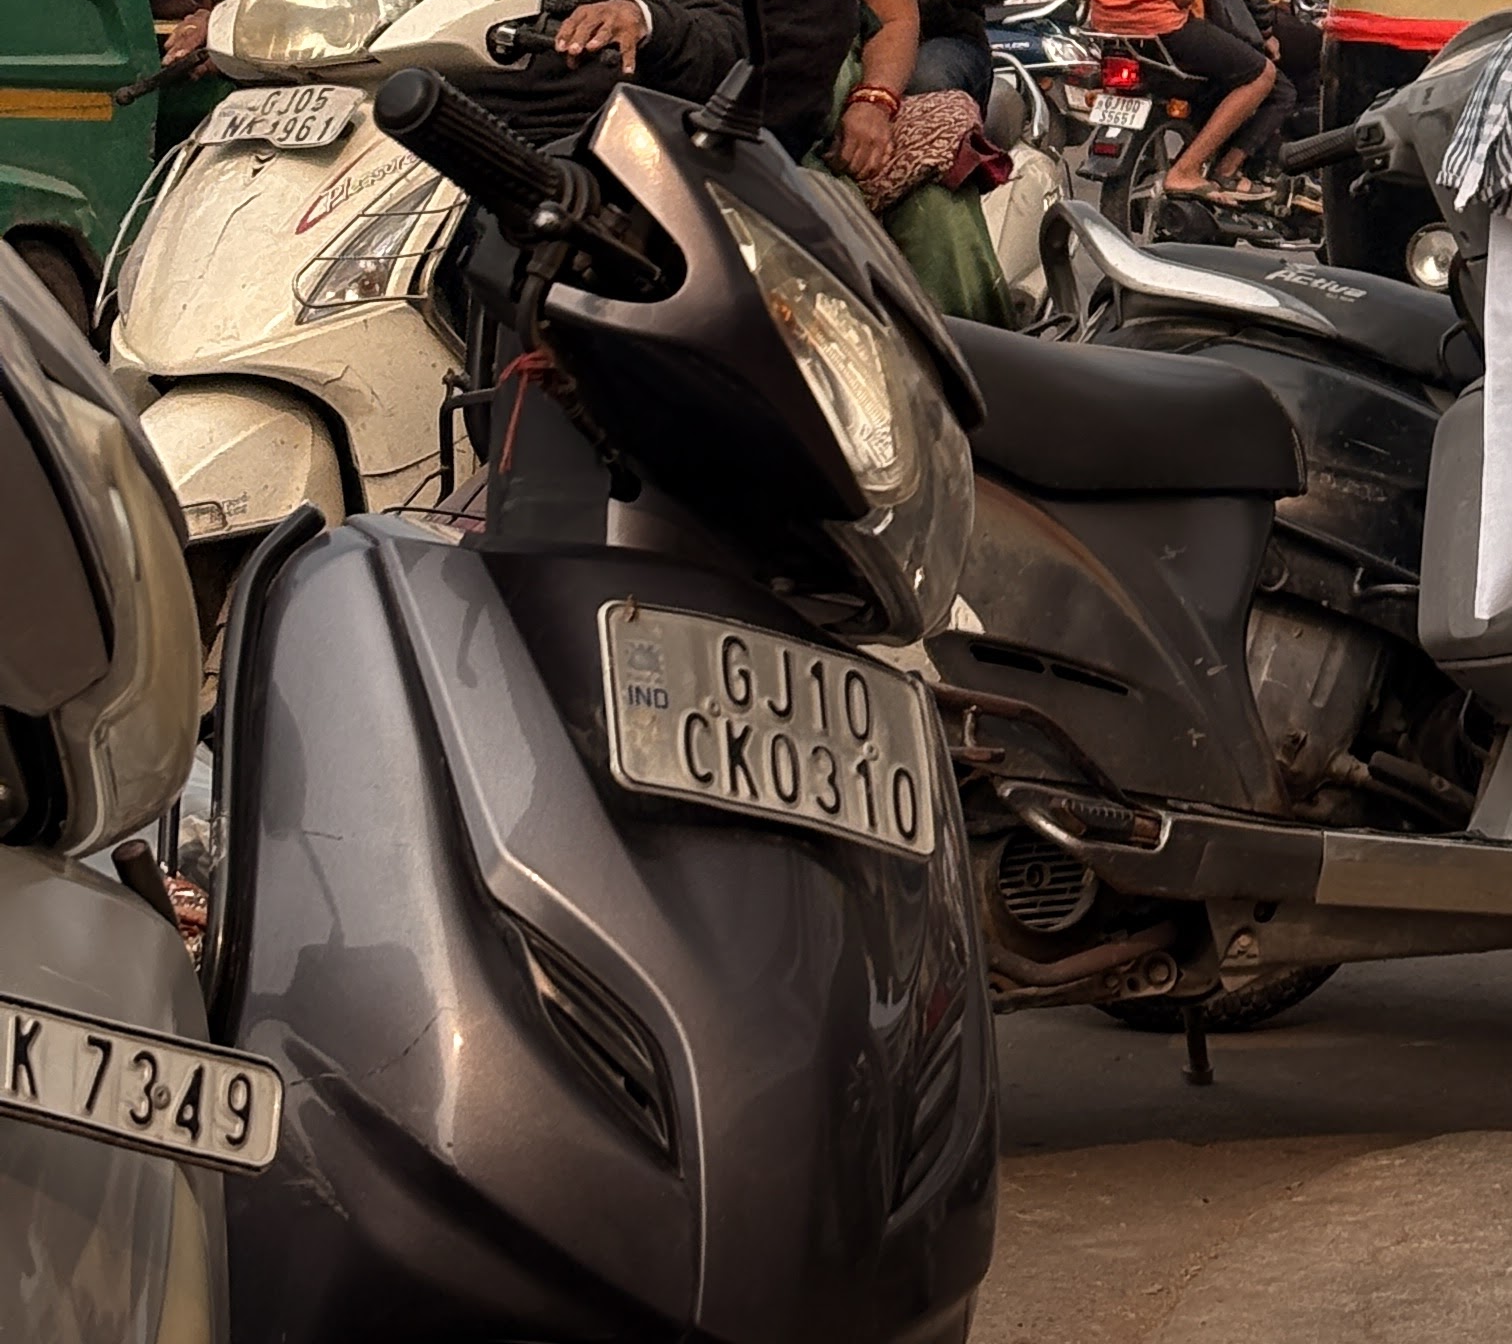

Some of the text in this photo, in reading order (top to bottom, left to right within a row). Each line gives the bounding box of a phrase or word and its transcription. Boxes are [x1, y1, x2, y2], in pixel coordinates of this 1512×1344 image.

[627, 684, 668, 709] IND
[721, 635, 871, 742] GJ10
[682, 712, 917, 842] CK0310
[80, 1034, 252, 1146] 7349
